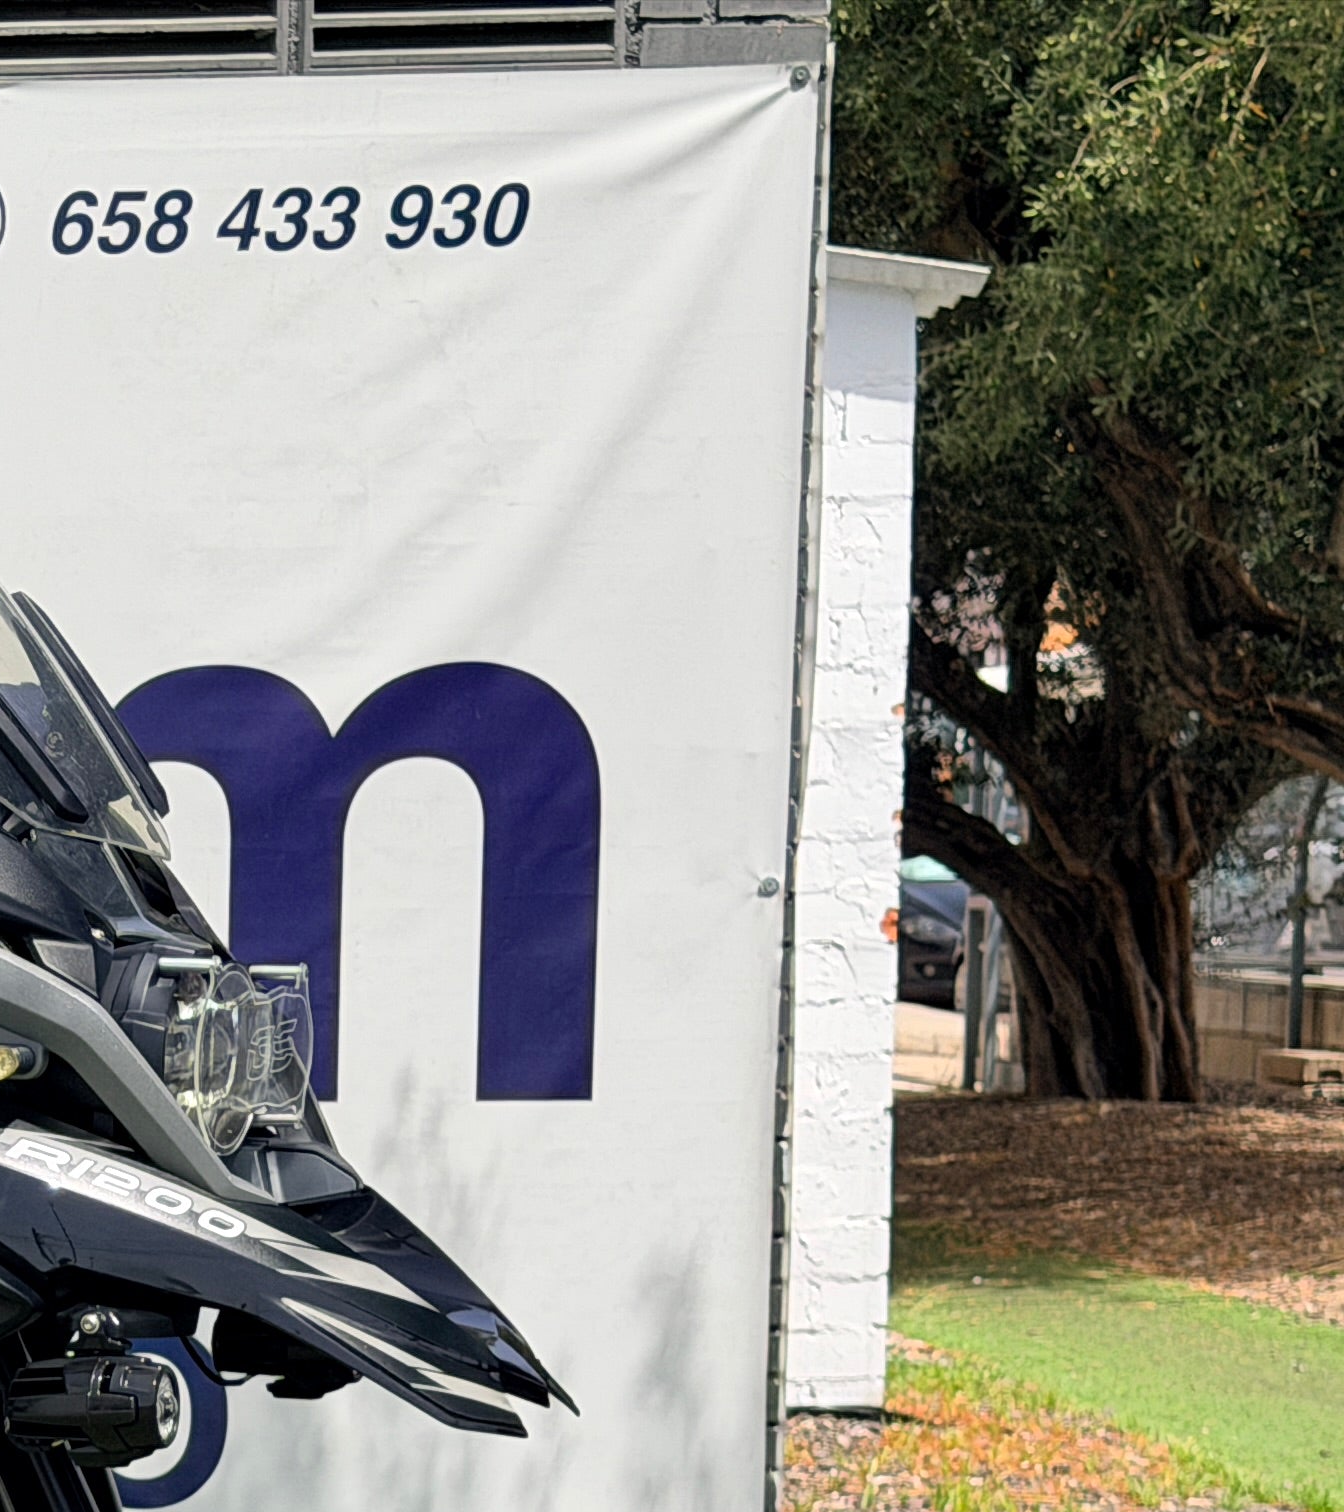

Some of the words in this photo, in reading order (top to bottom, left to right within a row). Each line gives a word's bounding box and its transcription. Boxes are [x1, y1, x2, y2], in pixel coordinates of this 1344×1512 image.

[52, 190, 193, 255] 658
[217, 187, 361, 252] 433
[385, 182, 530, 249] 930
[6, 1137, 247, 1239] R1200
